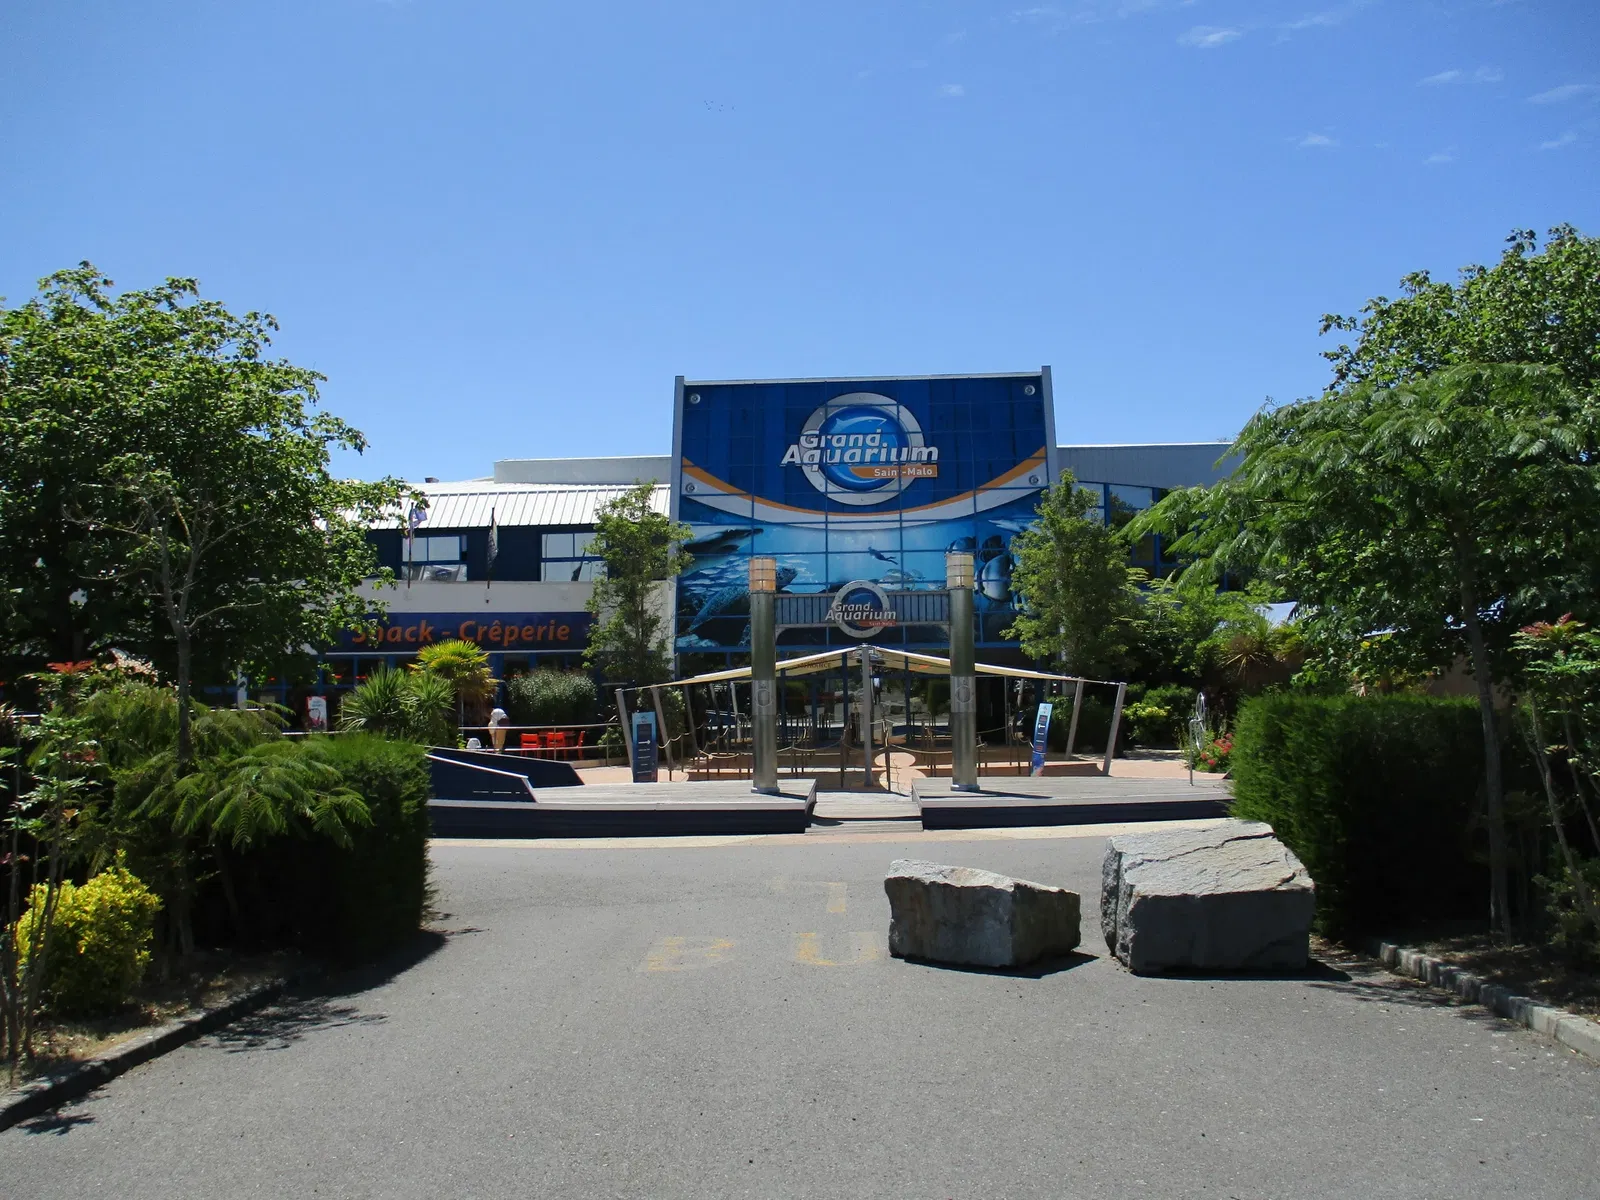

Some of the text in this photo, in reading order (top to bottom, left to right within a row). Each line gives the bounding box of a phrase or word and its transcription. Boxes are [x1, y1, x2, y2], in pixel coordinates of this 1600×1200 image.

[799, 428, 882, 448] Grand
[779, 442, 939, 473] Aquarium
[824, 608, 897, 623] Aquarium
[833, 601, 871, 612] Grand
[459, 620, 570, 646] Crêperie
